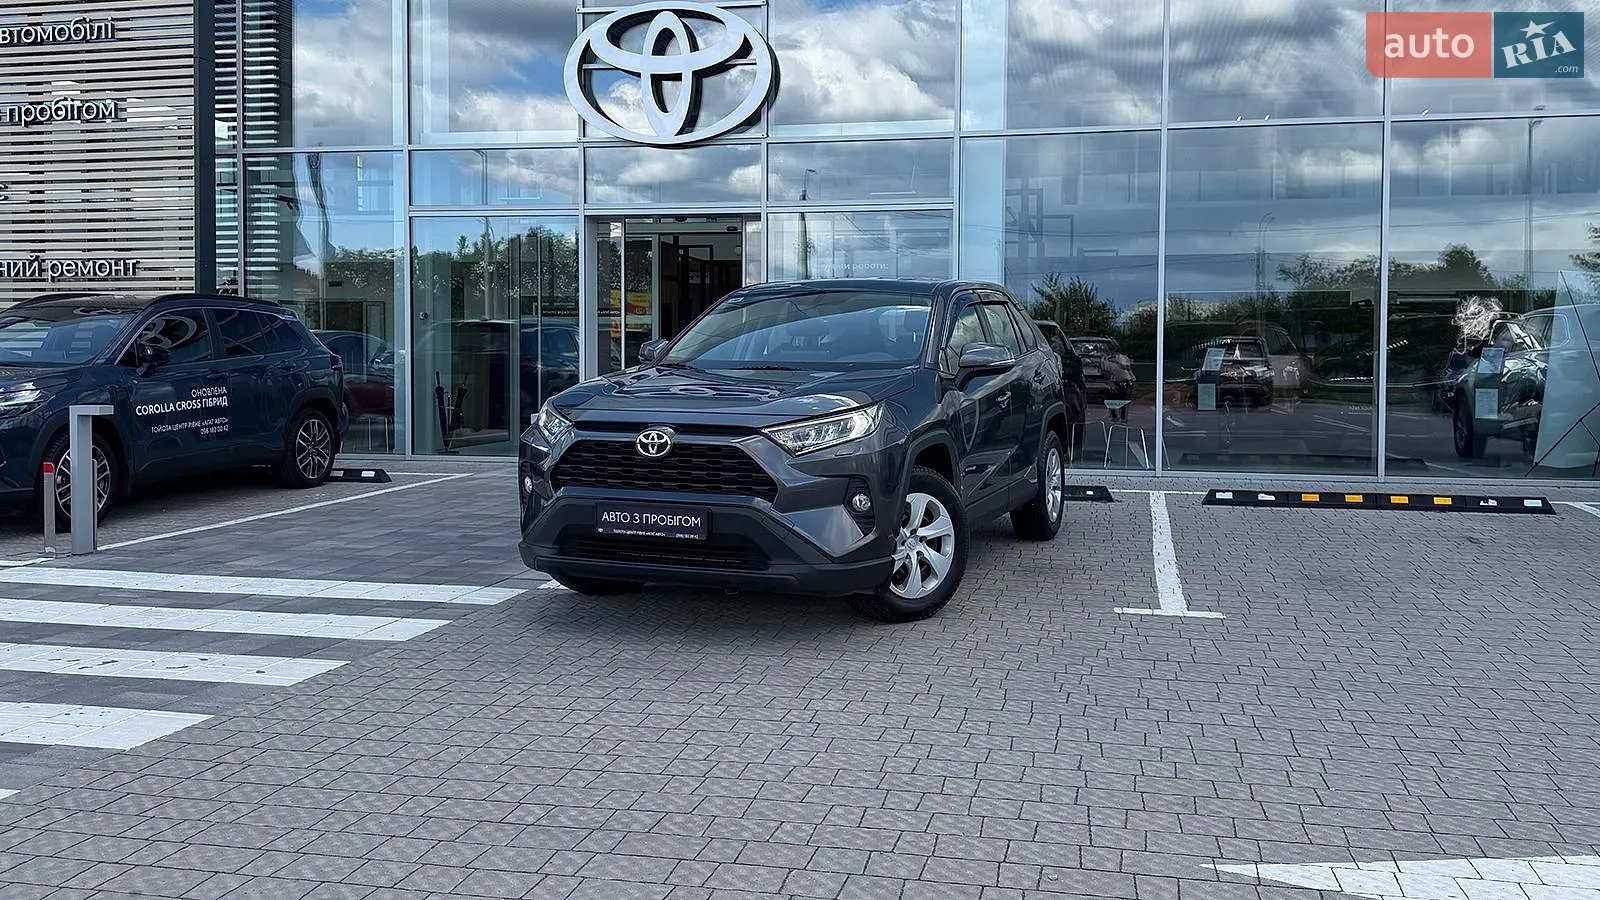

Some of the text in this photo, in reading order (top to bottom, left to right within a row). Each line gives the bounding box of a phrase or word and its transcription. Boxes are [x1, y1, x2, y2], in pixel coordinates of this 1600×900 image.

[0, 16, 112, 44] втомобілі
[6, 97, 116, 127] пробігом
[49, 257, 138, 283] ремонт
[191, 386, 228, 398] ОНОВЛЕНА
[135, 402, 176, 416] COROLLA
[175, 399, 202, 411] CROSS
[601, 511, 631, 523] АВТО
[642, 513, 701, 528] ПРОБІГОМ
